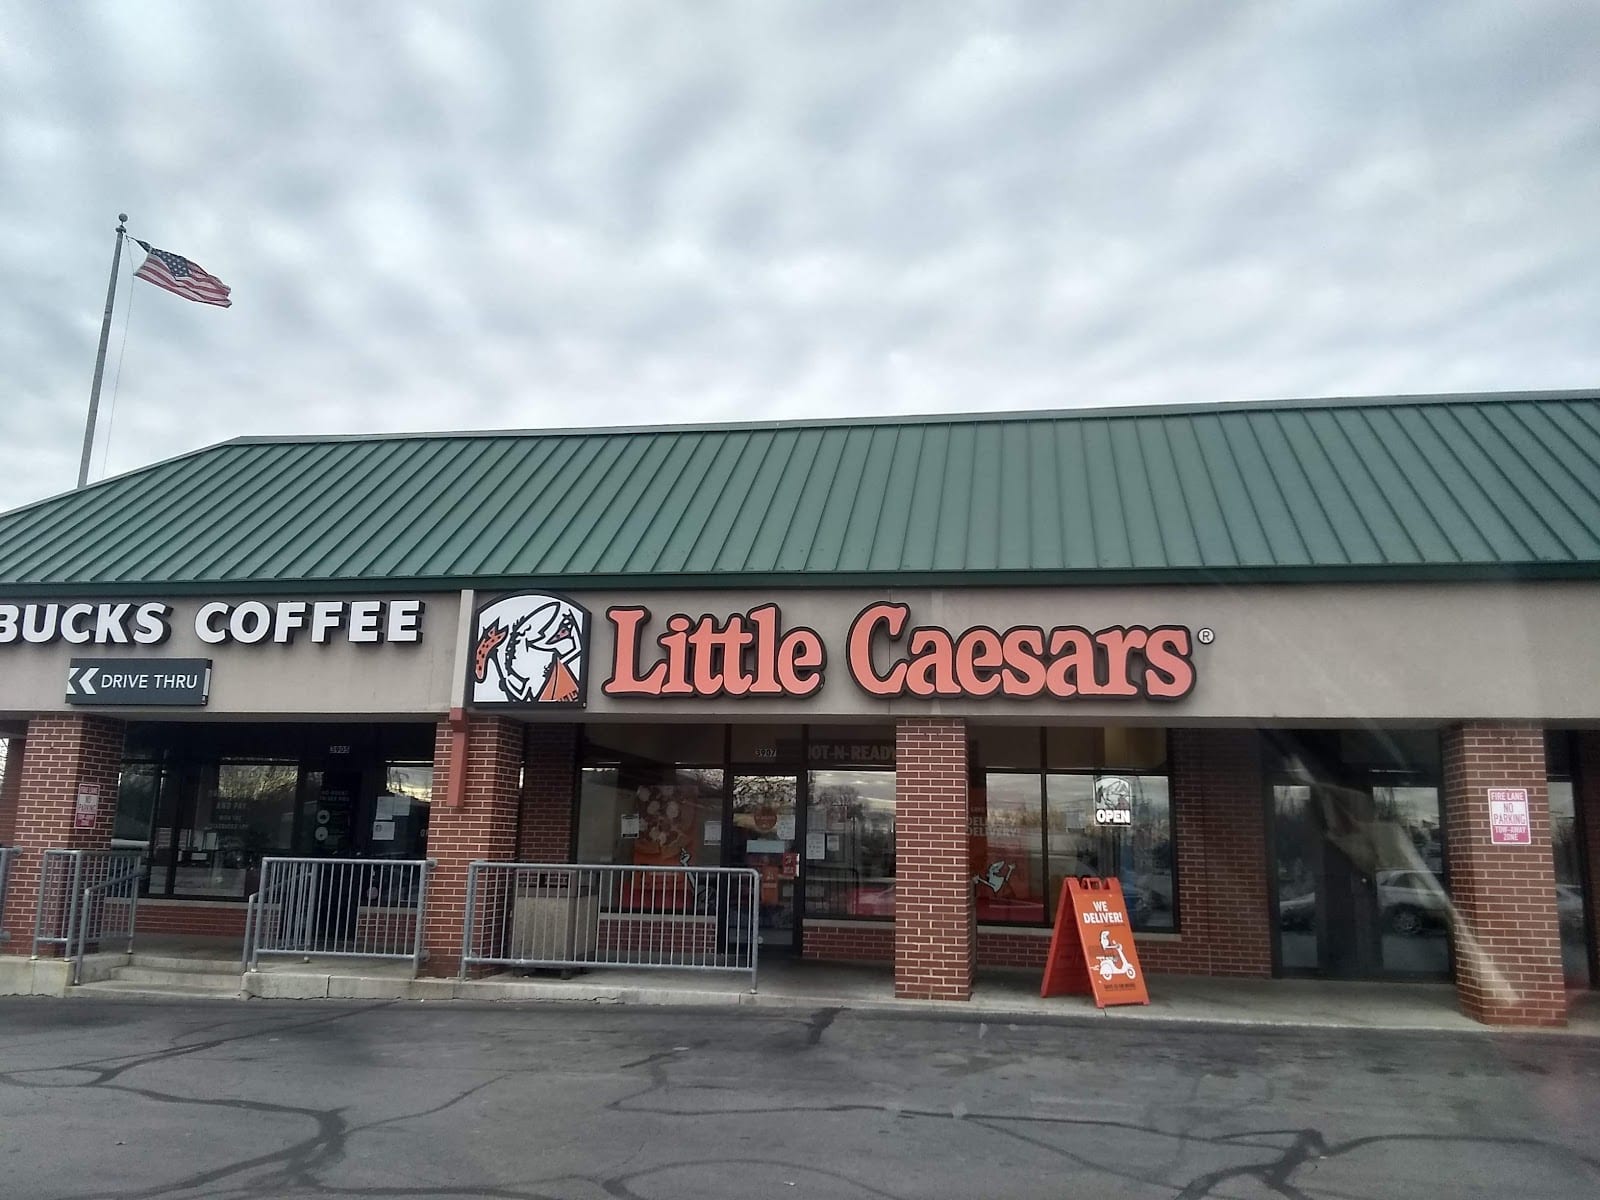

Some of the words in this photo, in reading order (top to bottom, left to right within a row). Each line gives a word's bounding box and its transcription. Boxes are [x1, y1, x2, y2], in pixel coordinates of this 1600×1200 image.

[0, 603, 170, 644] BUCKS
[194, 600, 423, 644] COFFEE
[602, 603, 826, 698] Little
[847, 602, 1196, 699] Caesars
[101, 674, 149, 689] DRIVE
[153, 674, 198, 689] THRU
[1491, 792, 1505, 800] FIRE
[1508, 792, 1524, 800] LANE
[1503, 802, 1514, 813] NO
[1096, 809, 1131, 823] OPEN
[1493, 814, 1526, 824] PARKING
[1092, 901, 1109, 912] WE
[1083, 912, 1124, 924] DELIVER!
